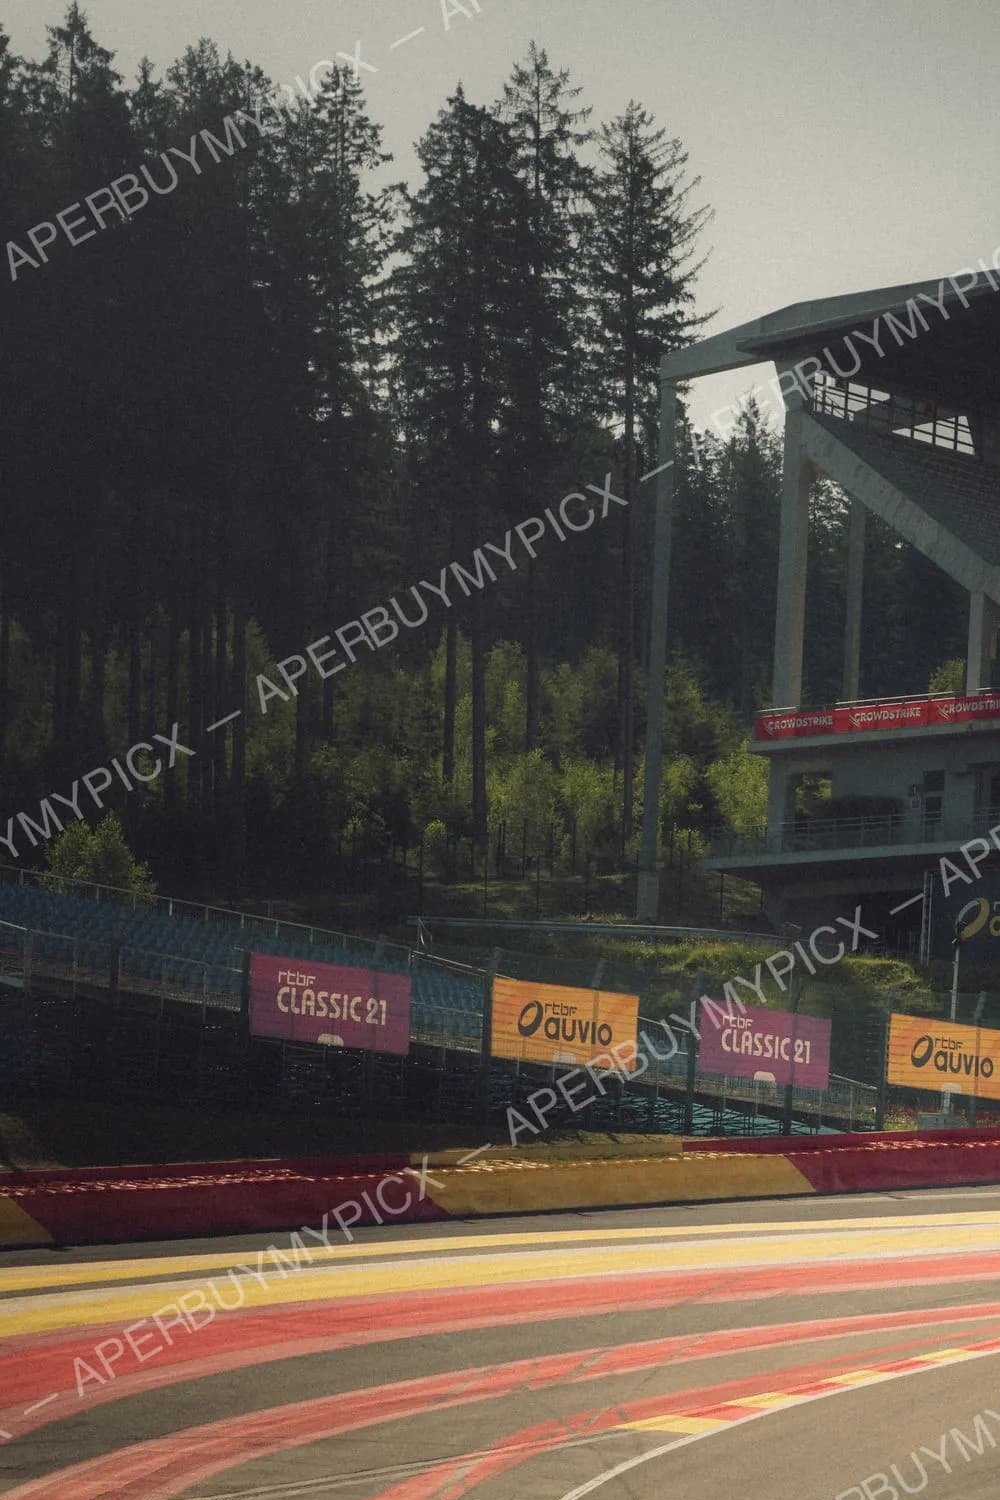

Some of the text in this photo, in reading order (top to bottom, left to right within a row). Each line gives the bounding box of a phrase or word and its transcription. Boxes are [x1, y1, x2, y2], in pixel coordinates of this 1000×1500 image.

[766, 714, 833, 731] CROWDSTRIKE
[853, 706, 921, 723] CROWDSTRIKE
[277, 987, 387, 1026] CLASSIC 21
[543, 1016, 613, 1047] auvio
[721, 1028, 812, 1065] CLASSIC 21
[933, 1050, 994, 1079] auvio
